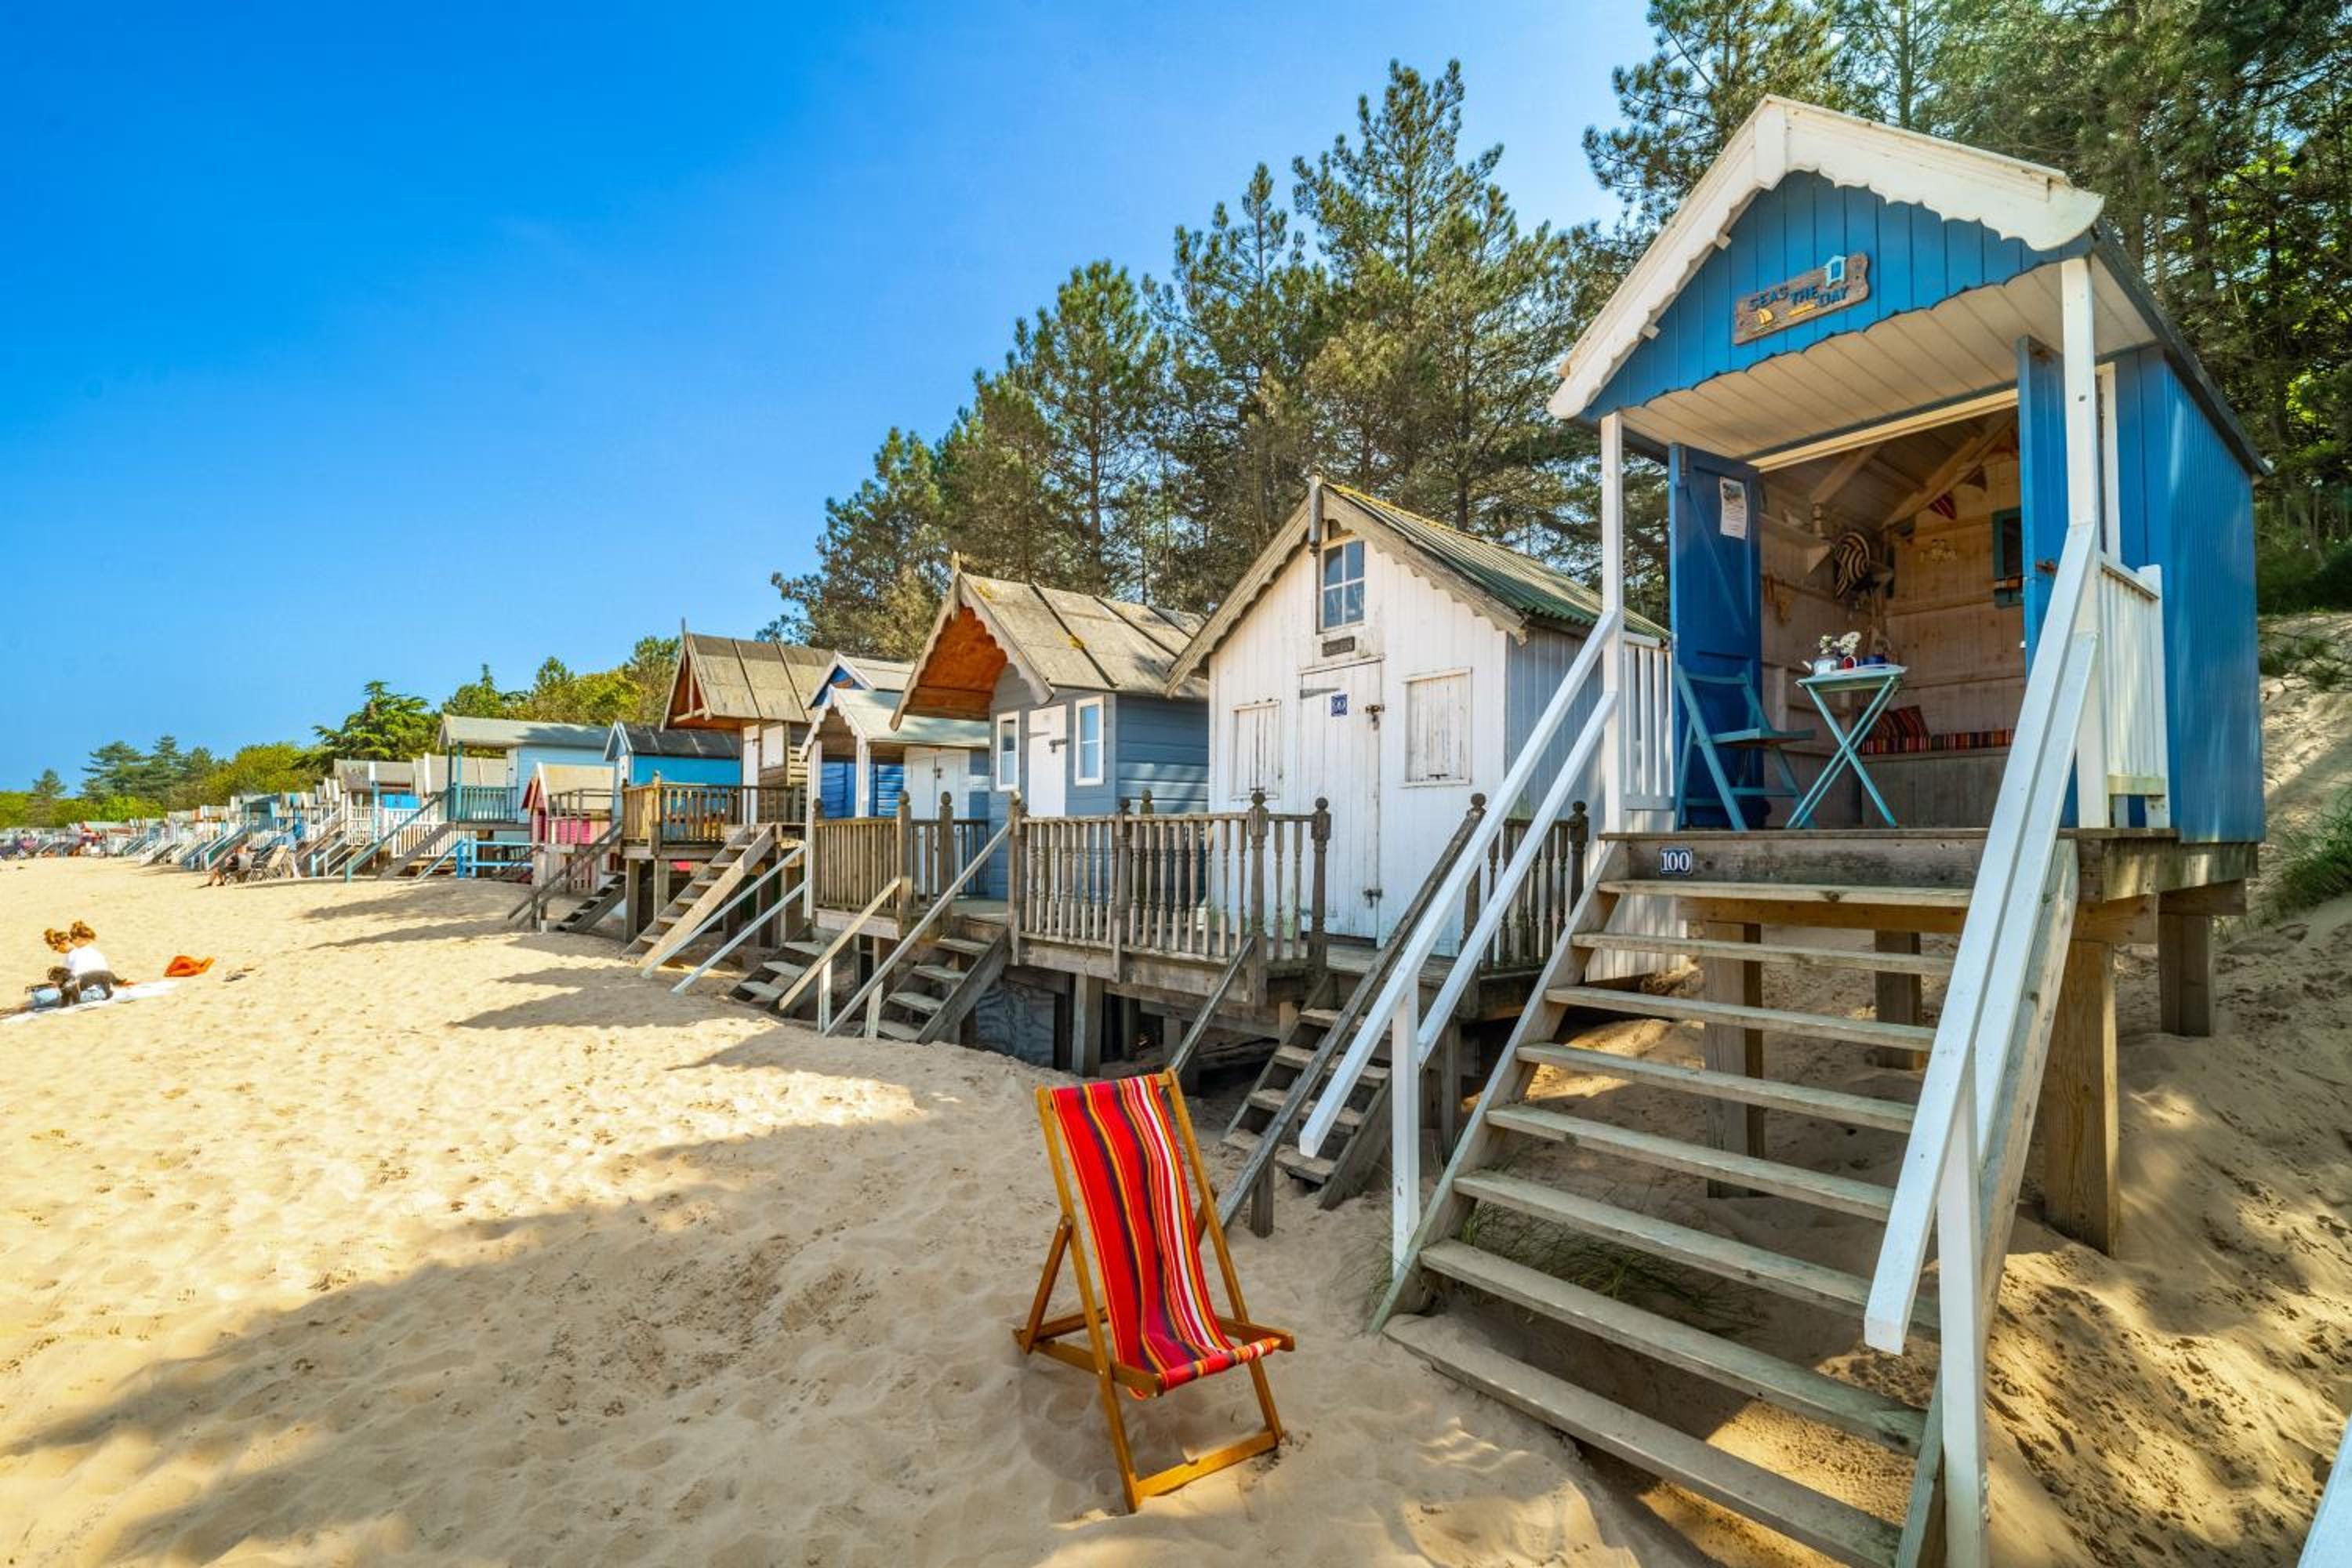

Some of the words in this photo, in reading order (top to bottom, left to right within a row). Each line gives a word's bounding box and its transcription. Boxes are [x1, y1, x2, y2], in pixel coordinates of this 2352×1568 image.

[1789, 285, 1817, 306] THE
[1816, 285, 1849, 307] DAY
[1661, 852, 1690, 870] 100
